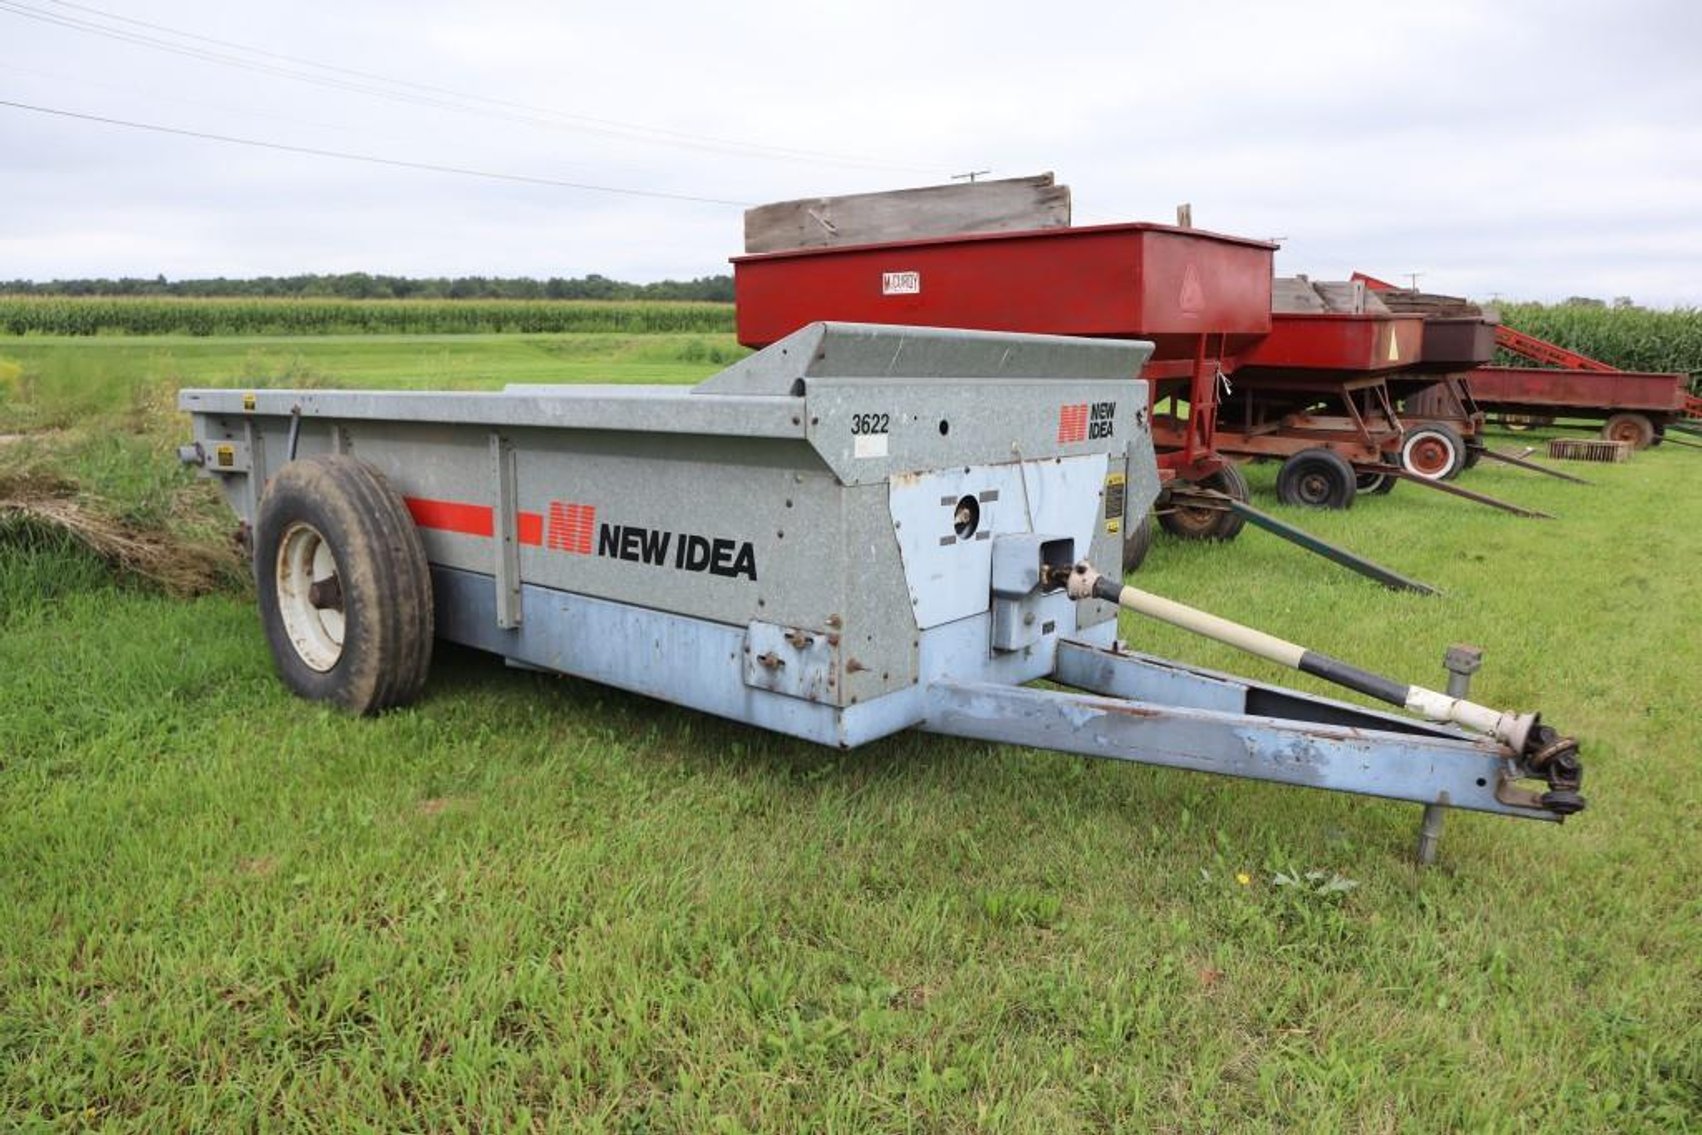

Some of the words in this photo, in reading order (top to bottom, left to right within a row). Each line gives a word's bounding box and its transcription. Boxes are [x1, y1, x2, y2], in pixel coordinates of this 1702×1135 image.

[1090, 402, 1116, 420] NEW
[851, 413, 890, 435] 3622
[1088, 420, 1114, 440] IDEA
[598, 523, 671, 566] NEW
[675, 533, 758, 581] IDEA
